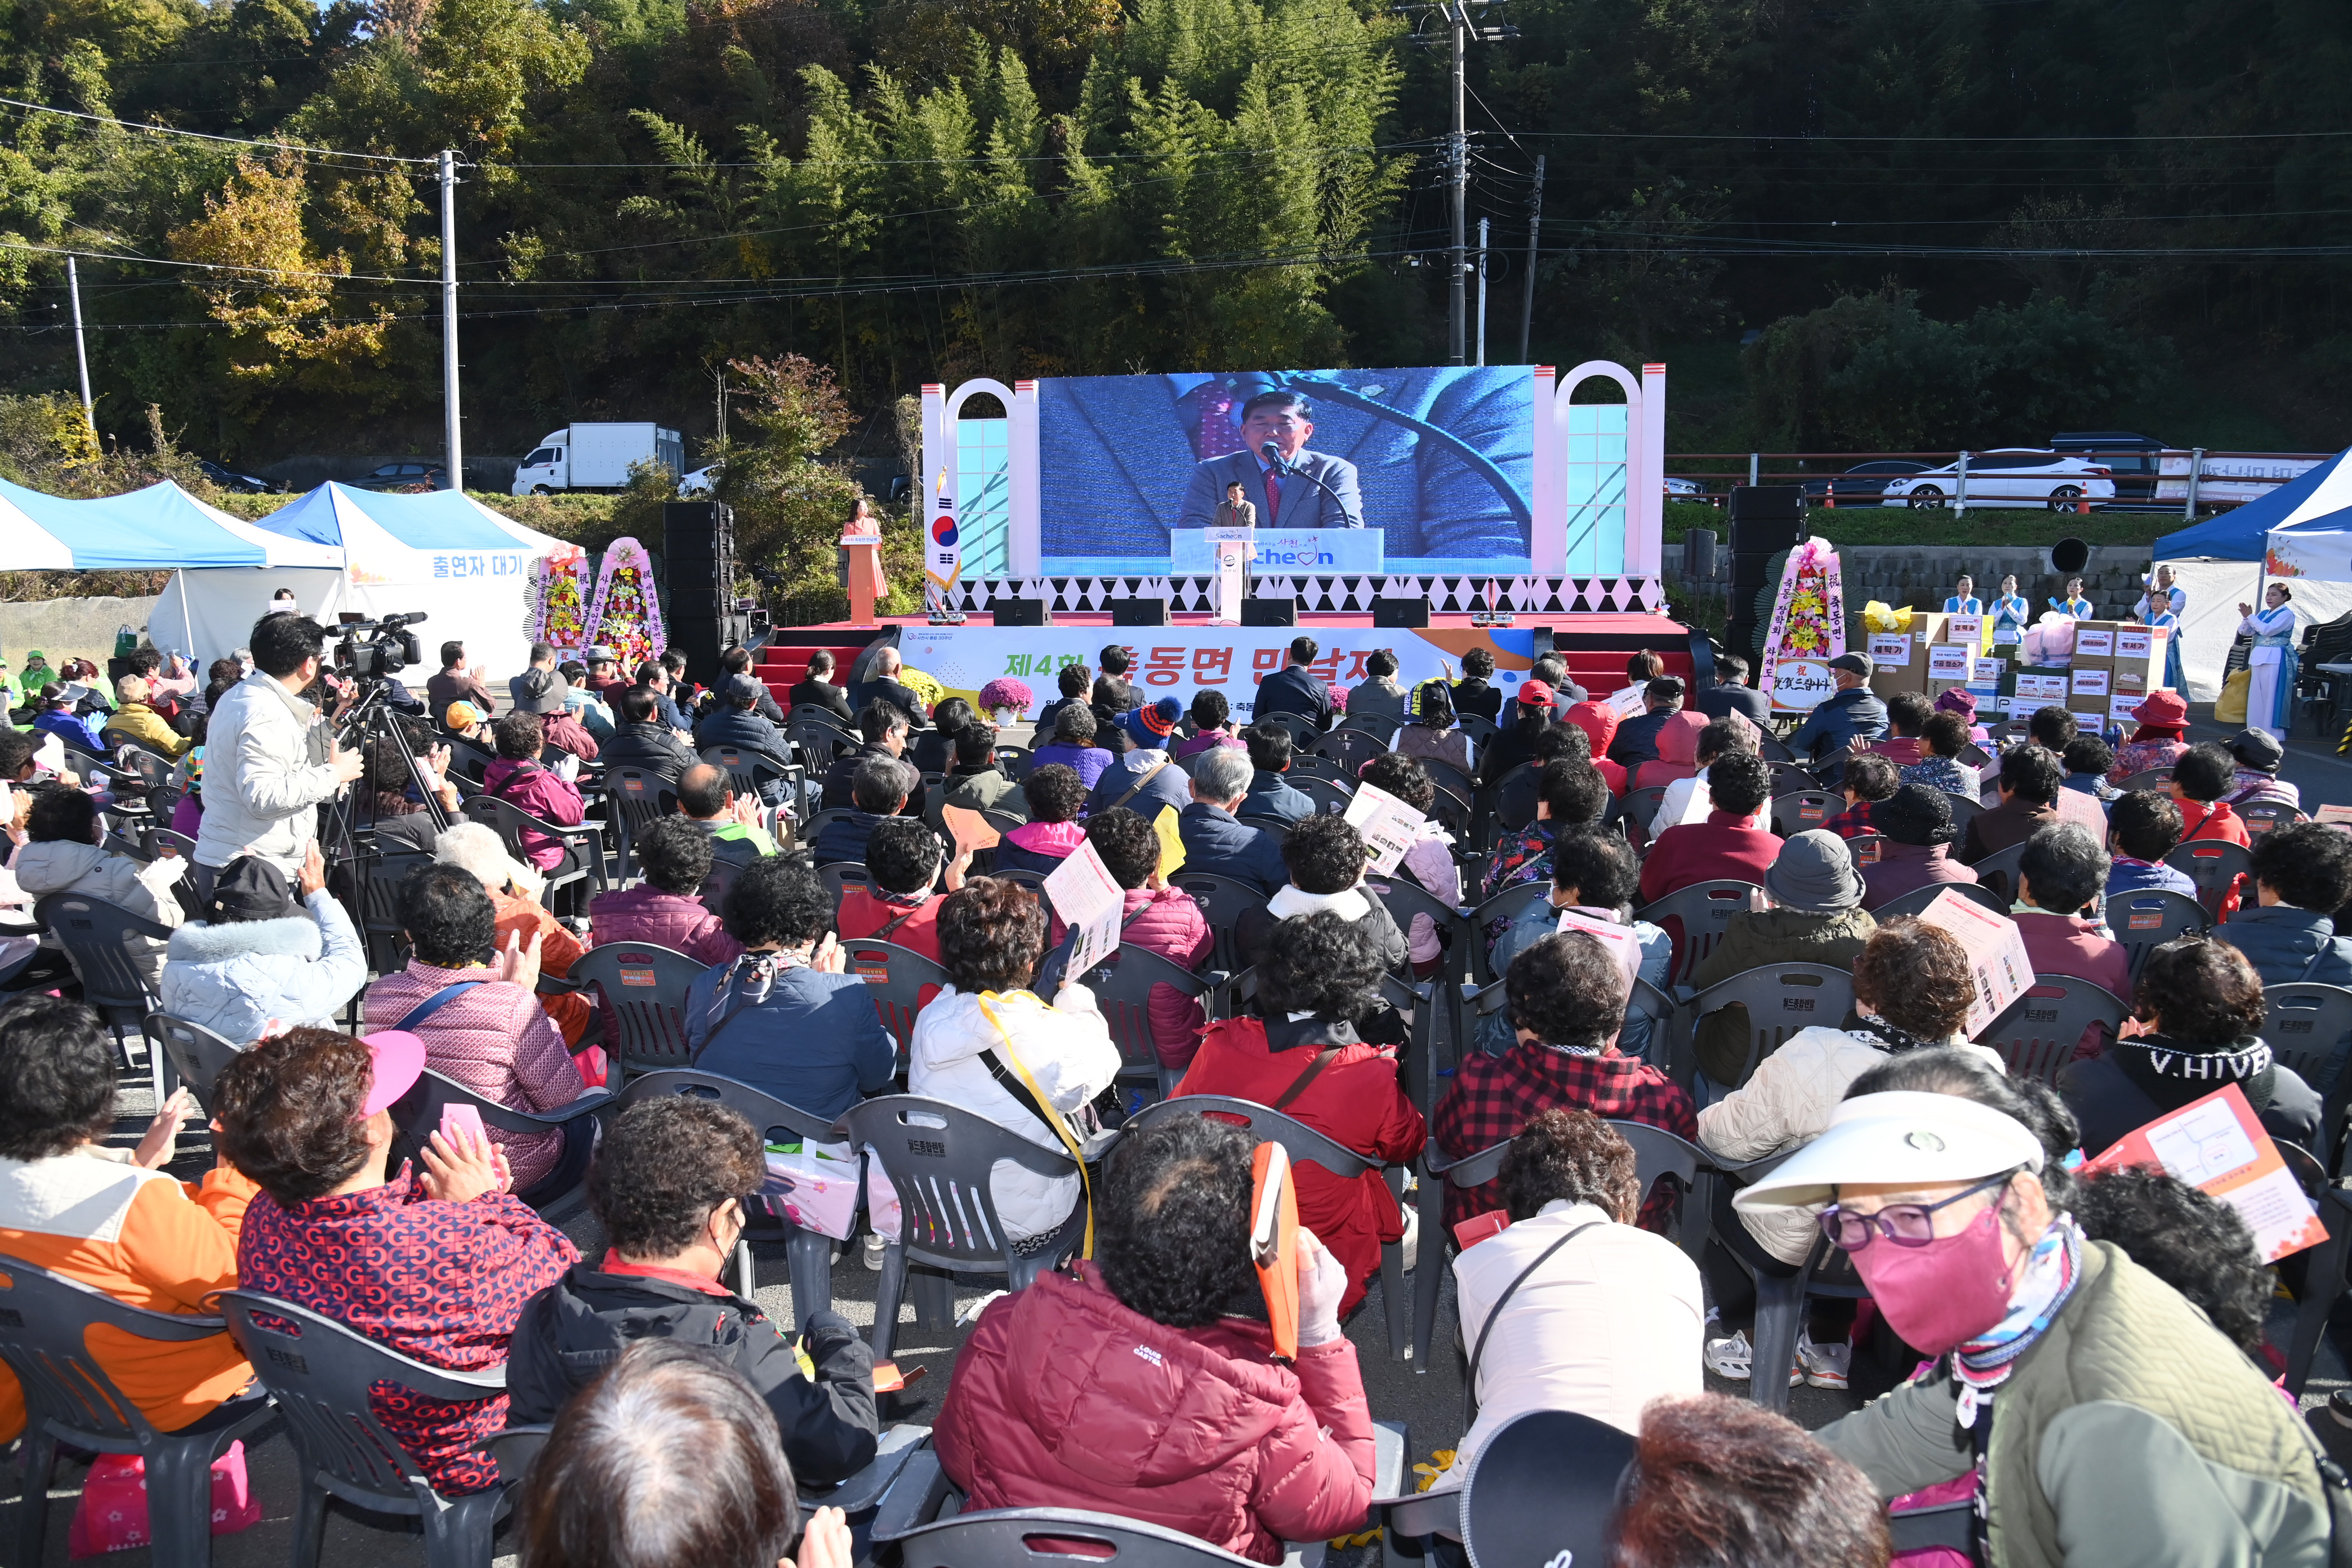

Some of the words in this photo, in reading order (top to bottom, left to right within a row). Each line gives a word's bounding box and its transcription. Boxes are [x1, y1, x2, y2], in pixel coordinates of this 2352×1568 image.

[434, 556, 485, 578] 출연자
[492, 555, 522, 576] 대기
[579, 572, 589, 585] 祝
[643, 570, 652, 580] 祝
[1828, 574, 1840, 587] 祝
[1780, 577, 1793, 599] 축동
[577, 574, 609, 661] 사천농업협동조
[645, 583, 656, 609] 제4회
[651, 614, 661, 639] 축동면
[1829, 595, 1842, 640] 축동면
[1771, 605, 1788, 636] 장학회
[1874, 645, 1902, 654] 세탁기
[1796, 665, 1807, 676] 祝
[1783, 997, 1815, 1009] 월드종합렌탈
[2024, 1009, 2058, 1019] 월드종합렌탈
[907, 1138, 945, 1154] 월드종합렌탈
[1133, 1348, 1161, 1367] CASTEL
[1139, 1344, 1162, 1360] LOUIS
